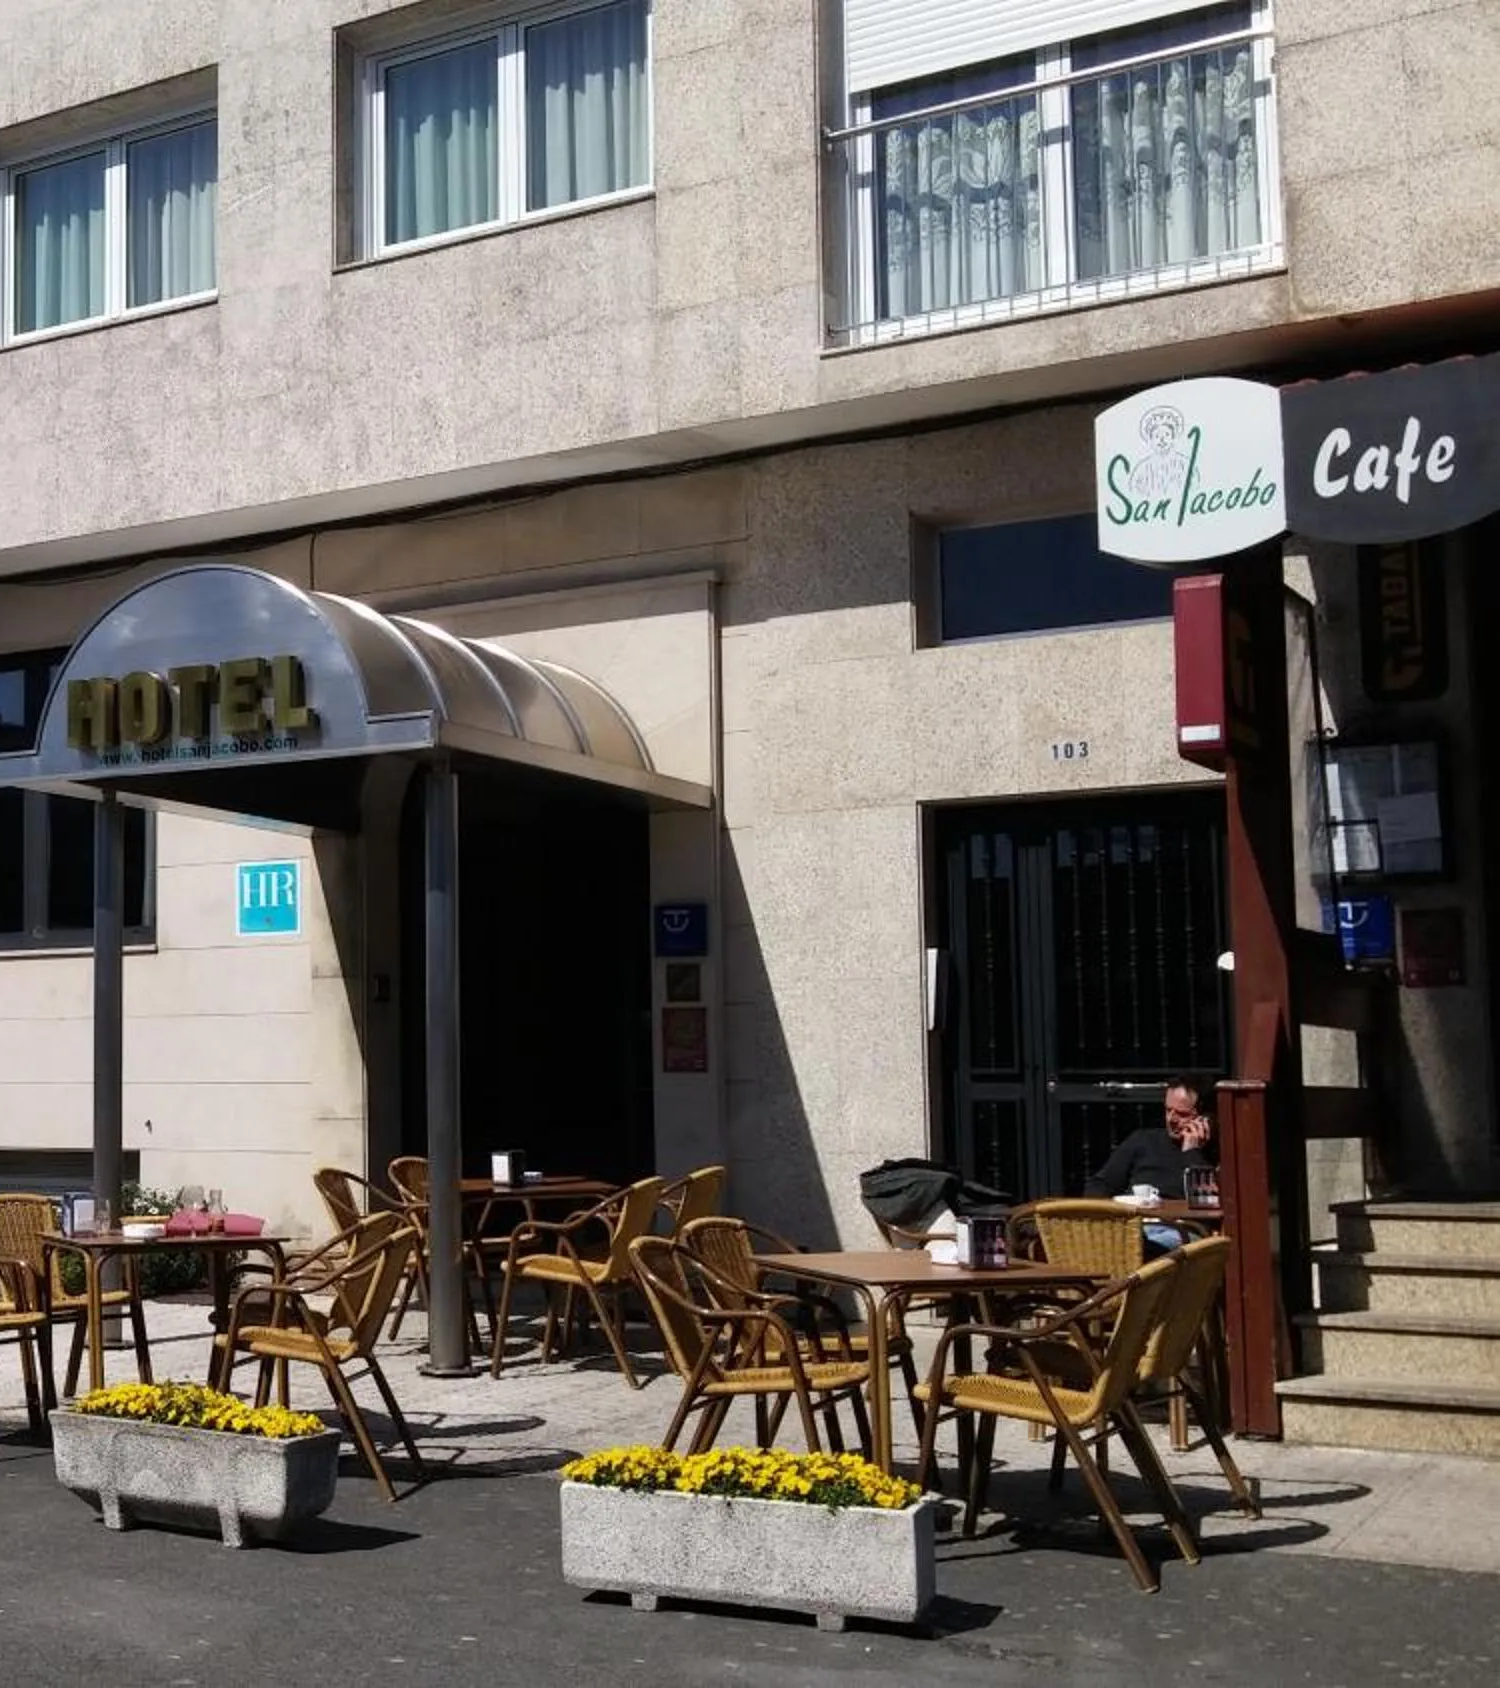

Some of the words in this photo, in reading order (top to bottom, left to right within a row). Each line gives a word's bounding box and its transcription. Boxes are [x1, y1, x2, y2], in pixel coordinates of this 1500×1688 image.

[1106, 454, 1169, 525] San
[1313, 416, 1456, 504] Cafe
[66, 655, 315, 750] HOTEL
[1051, 741, 1089, 760] 103
[243, 871, 294, 908] HR
